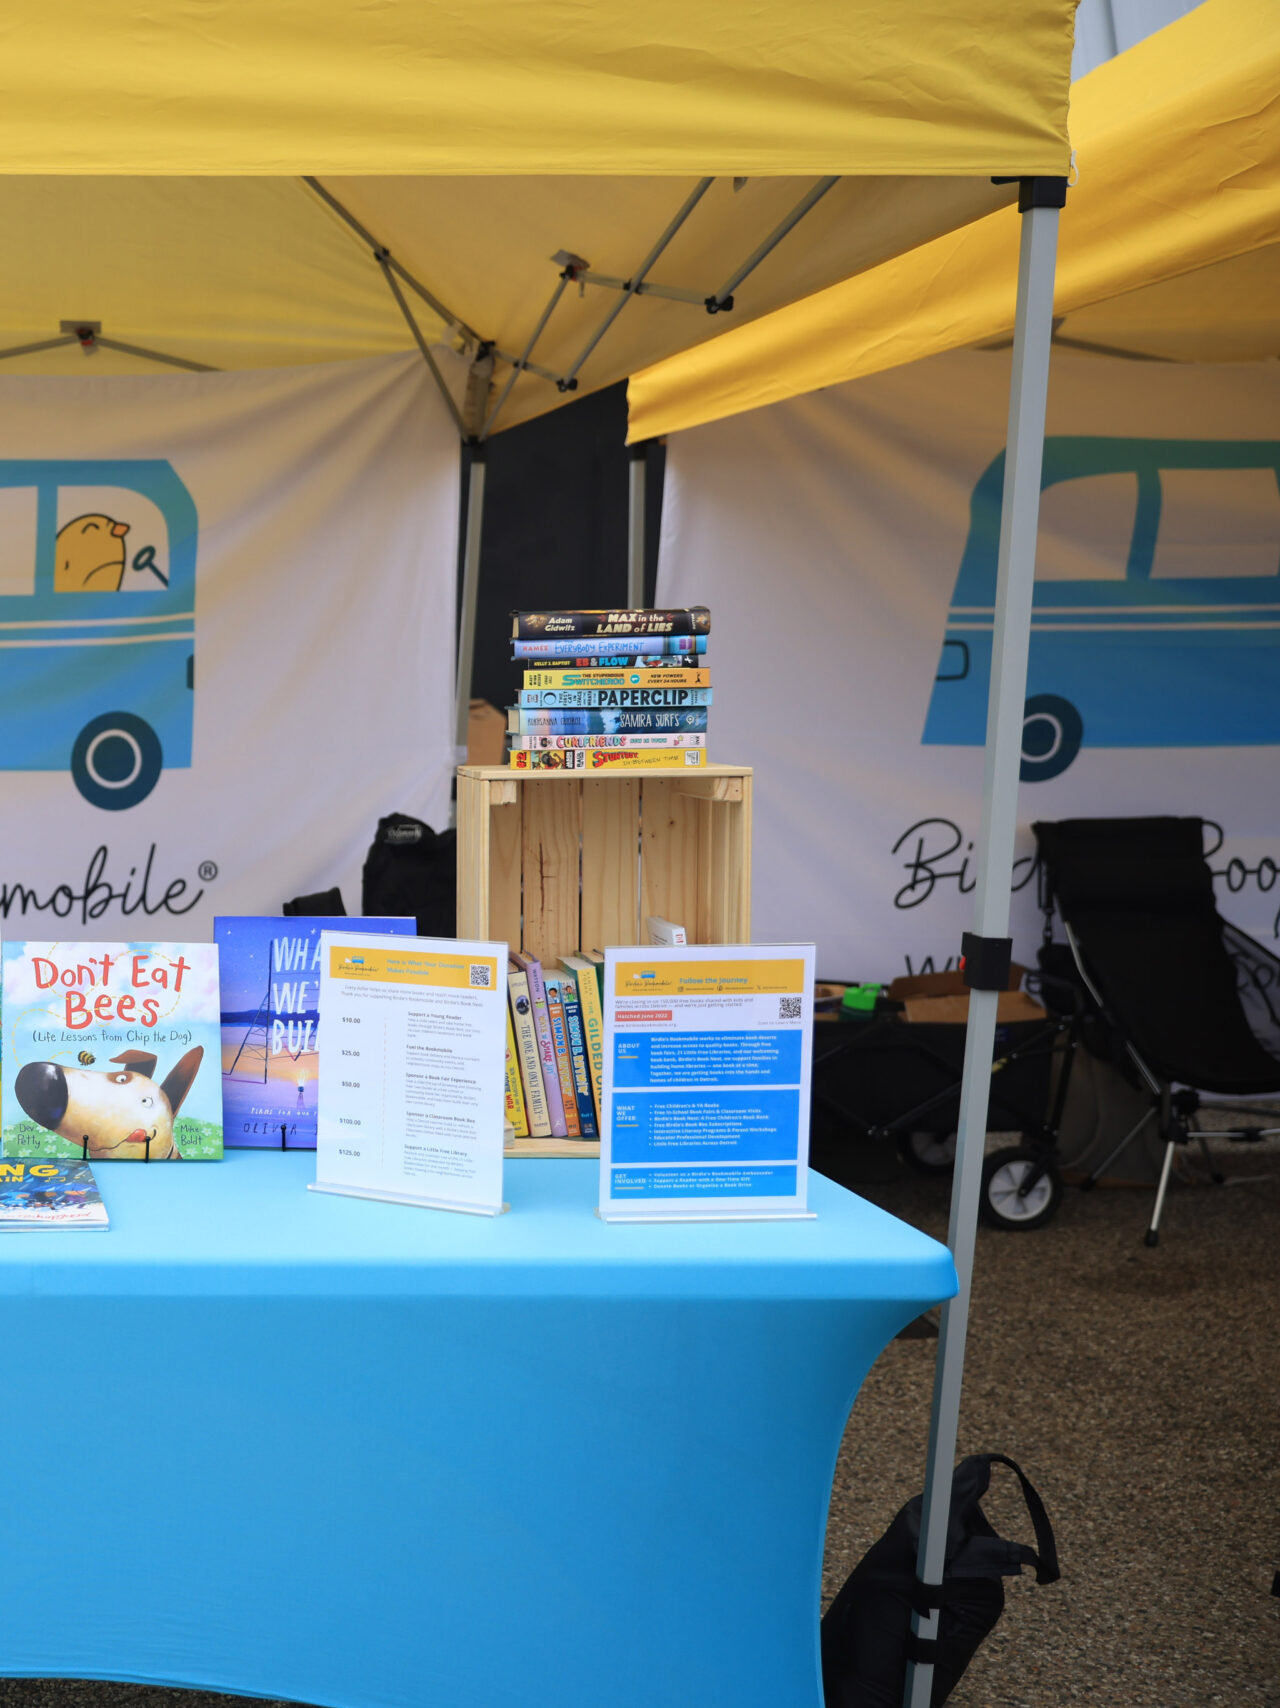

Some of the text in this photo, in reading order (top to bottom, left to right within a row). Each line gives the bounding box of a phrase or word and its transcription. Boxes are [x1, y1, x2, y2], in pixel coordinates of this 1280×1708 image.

[608, 613, 664, 622] MAX in the
[596, 623, 673, 633] LAND of LIES
[576, 656, 628, 667] EB & FLOW
[598, 690, 688, 706] PAPERCLIP
[620, 713, 680, 728] SAMIRA SURFS
[274, 936, 321, 972] WHA
[31, 954, 192, 992] Don't Eat
[65, 990, 160, 1029] Bees
[33, 1030, 192, 1045] (Life Lessons from Chip the Dog)
[552, 1017, 566, 1056] SIMON B.
[588, 1018, 603, 1070] GILDED
[520, 1024, 544, 1115] THE ONE AND ONLY FAMILY
[20, 1124, 34, 1133] Dev
[180, 1124, 199, 1133] Mike
[339, 1118, 361, 1126] $100.00
[17, 1134, 40, 1149] Petty
[180, 1134, 202, 1145] Boldt
[339, 1149, 361, 1157] $125.00
